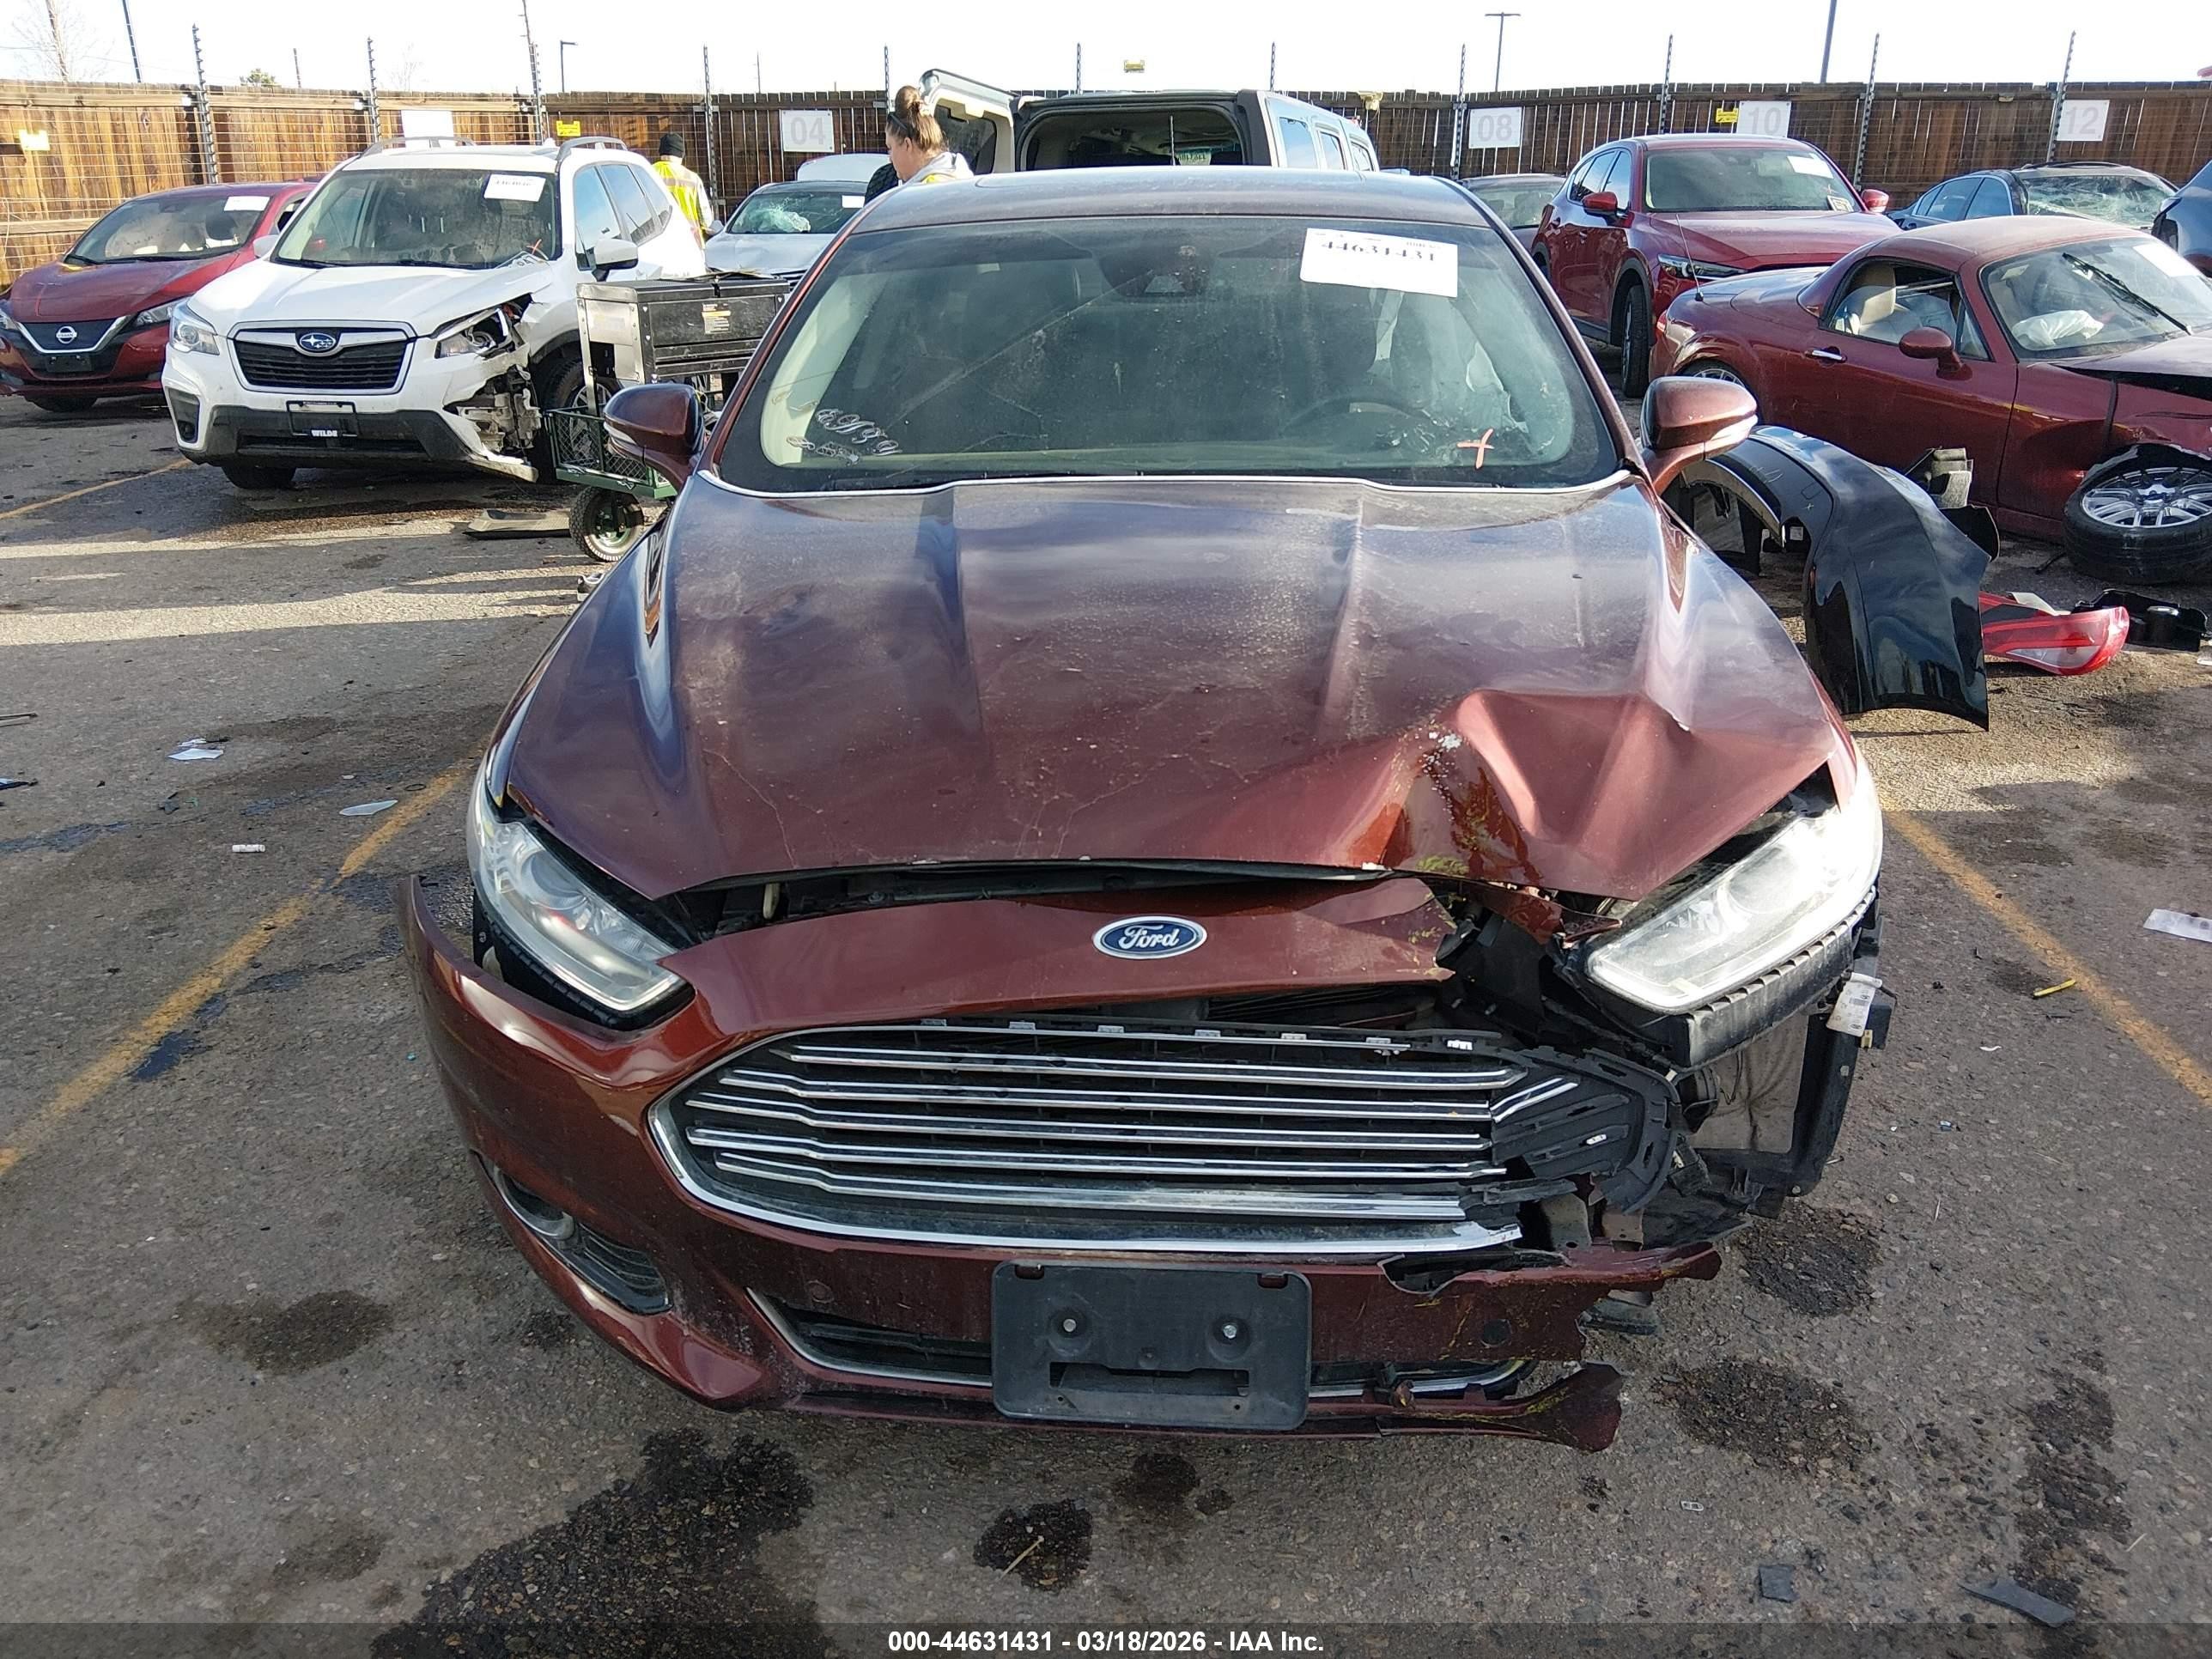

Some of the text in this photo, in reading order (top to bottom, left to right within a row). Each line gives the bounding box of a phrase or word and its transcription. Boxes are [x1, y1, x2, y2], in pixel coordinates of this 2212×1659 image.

[790, 117, 826, 145] 04
[1478, 114, 1511, 142] 08
[1748, 107, 1781, 134] 10
[2066, 106, 2099, 134] 12
[1118, 925, 1179, 949] Ford
